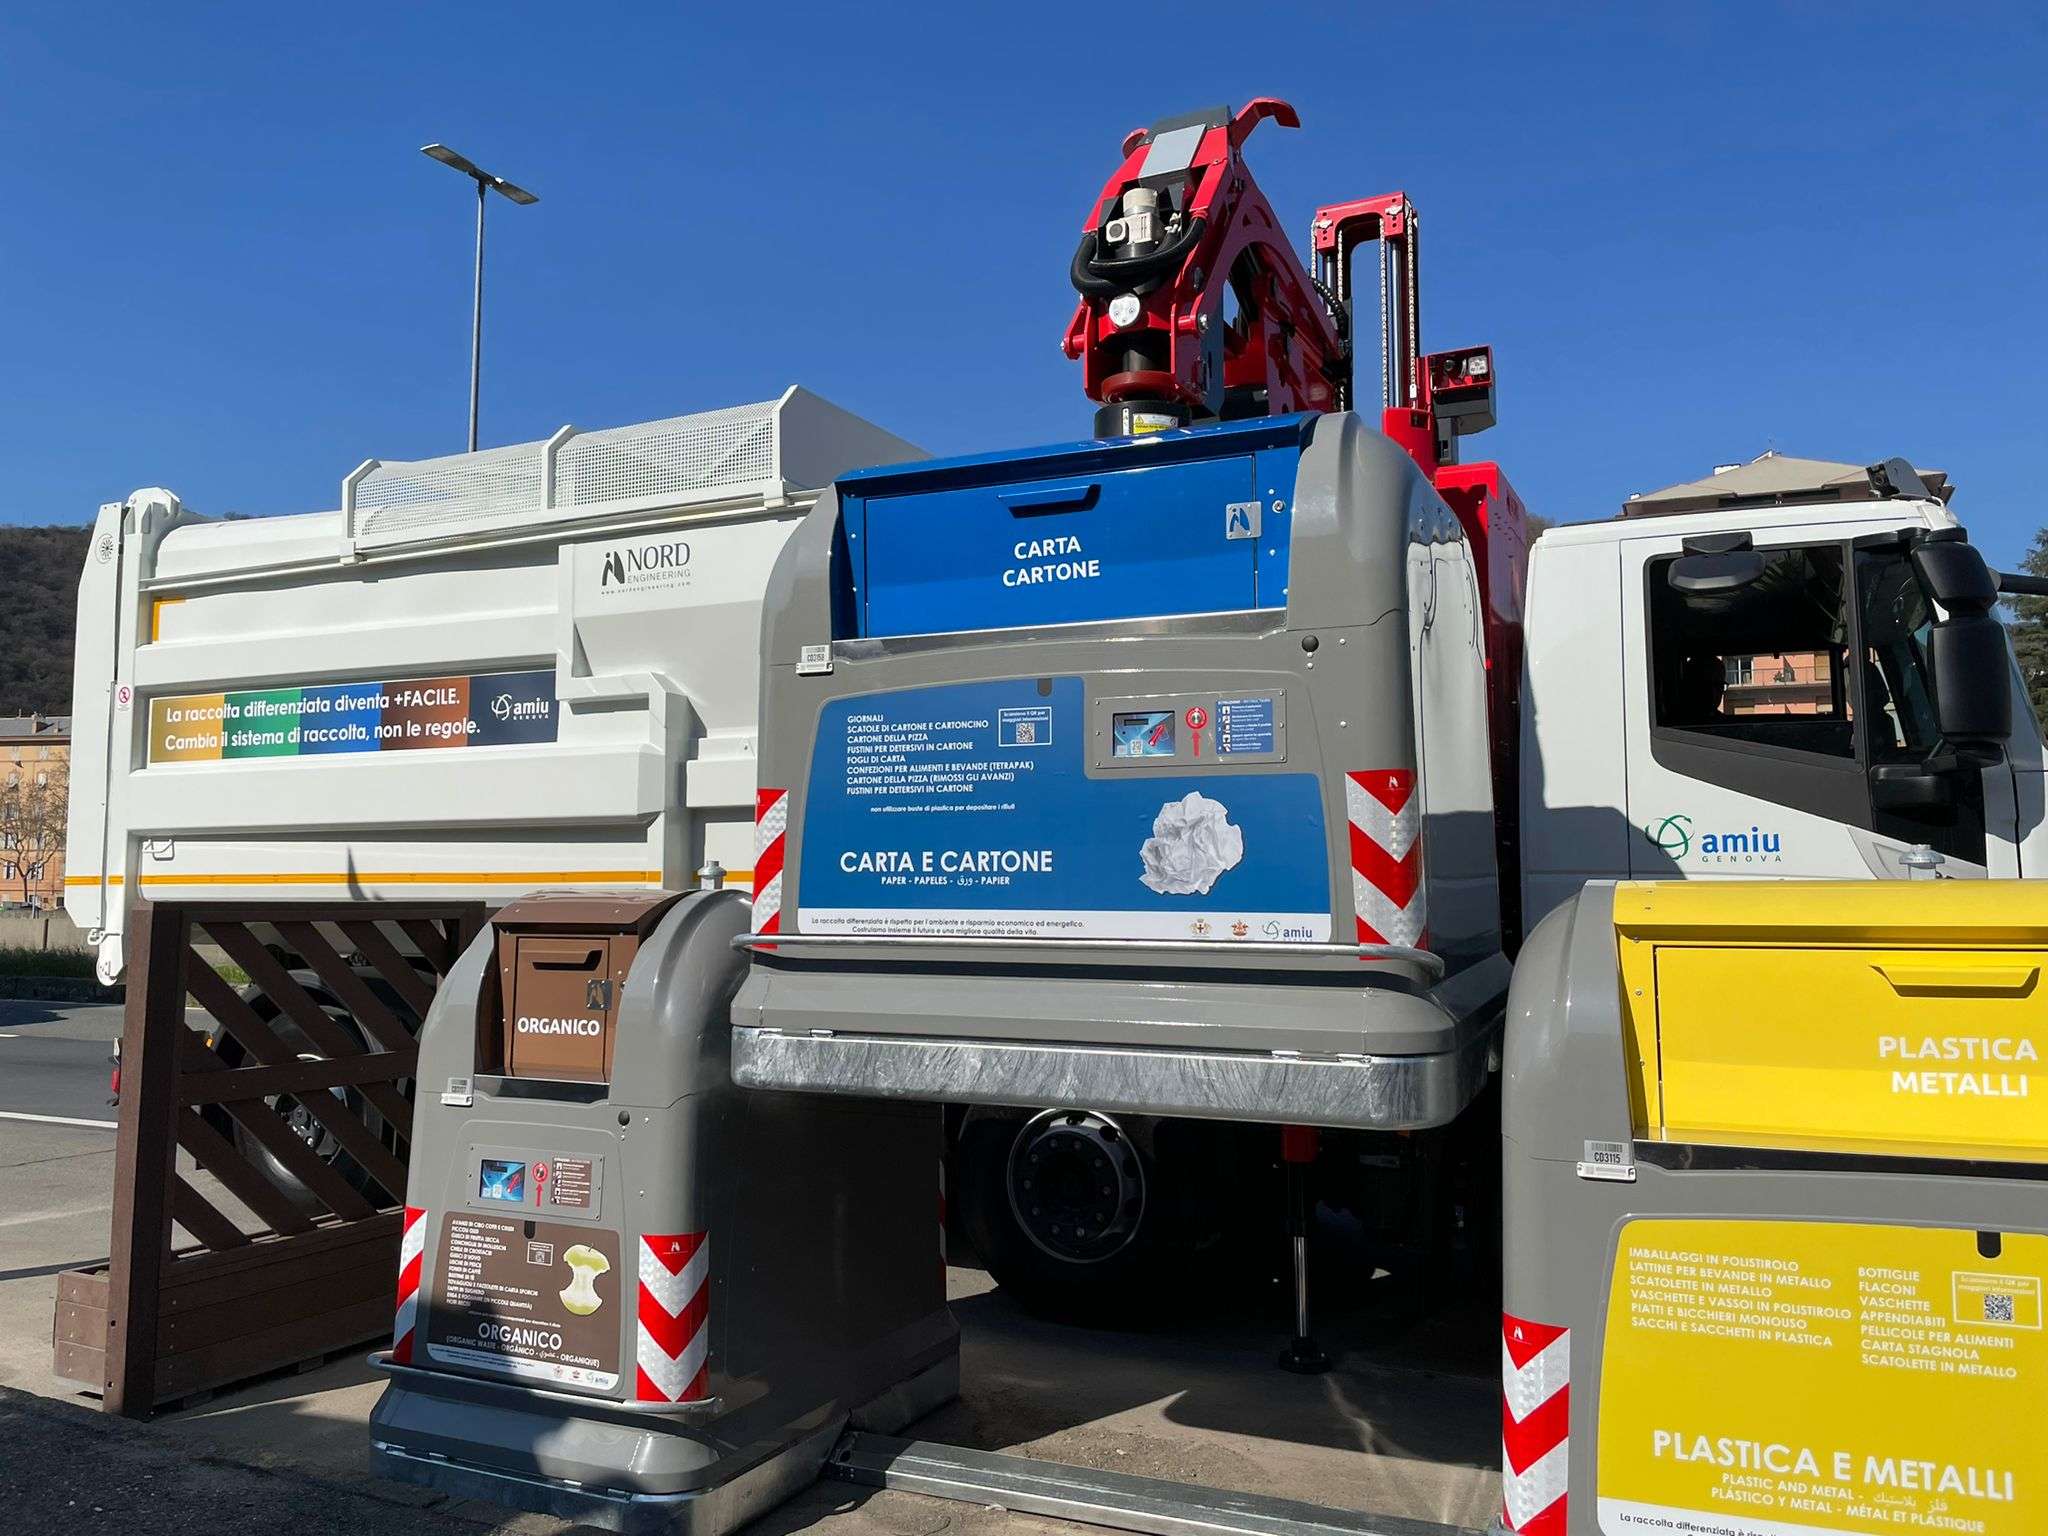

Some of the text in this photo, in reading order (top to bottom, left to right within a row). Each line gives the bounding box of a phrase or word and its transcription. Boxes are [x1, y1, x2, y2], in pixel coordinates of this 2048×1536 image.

[626, 542, 690, 572] NORD
[1014, 536, 1081, 560] CARTA
[628, 569, 691, 583] ENGINEERING
[1002, 560, 1100, 587] CARTONE
[167, 688, 460, 722] La raccolta differenziata diventa +FACILE.
[514, 699, 549, 717] amiu
[847, 715, 884, 724] GIORNALI
[847, 725, 880, 734] SCATOLE
[891, 723, 928, 732] CARTONE
[935, 720, 989, 730] CARTONCINO
[166, 717, 480, 751] Cambia il sistema di raccolta, non le regole.
[847, 733, 929, 744] CARTONE DELLA PIZZA
[847, 746, 874, 754] FUSTINI
[889, 743, 925, 752] DETERSIVI
[926, 743, 935, 751] IN
[936, 741, 973, 750] CARTONE
[847, 756, 870, 764] FOGLI
[880, 755, 906, 763] CARTA
[847, 766, 894, 775] CONFEZIONI
[909, 764, 944, 773] ALIMENTI
[951, 763, 988, 772] BEVANDE
[989, 761, 1034, 772] (TETRAPAK)
[846, 776, 883, 785] CARTONE
[884, 776, 907, 784] DELLA
[908, 775, 928, 783] PIZZA
[930, 773, 965, 783] (RIMOSSI
[980, 773, 1015, 782] AVANZI)
[889, 786, 925, 794] DETERSIVI
[936, 784, 974, 793] CARTONE
[1702, 826, 1780, 853] amiu
[840, 851, 1053, 873] CARTA E CARTONE
[881, 876, 907, 885] PAPER
[914, 876, 948, 885] PAPELES
[981, 876, 1010, 885] PAPIER
[1283, 926, 1312, 938] amiu
[518, 1017, 600, 1036] ORGANICO
[1878, 1036, 2038, 1061] PLASTICA
[1892, 1072, 2028, 1096] METALLI
[1629, 1248, 1800, 1272] IMBALLAGGI IN POLISTIROLO
[1630, 1262, 1832, 1289] LATTINE PER BEVANDE IN METALLO
[1630, 1275, 1772, 1298] SCATOLETTE IN METALLO
[1858, 1268, 1920, 1282] BOTTIGLIE
[1859, 1282, 1916, 1296] FLACONI
[1631, 1289, 1852, 1319] VASCHETTE E VASSOI IN POLISTIROLO
[1860, 1296, 1931, 1312] VASCHETTE
[1631, 1303, 1808, 1330] PIATTI E BICCHIERI MONOUSO
[1860, 1311, 1946, 1328] APPENDIABITI
[478, 1322, 562, 1350] ORGANICO
[1632, 1317, 1833, 1346] SACCHI E SACCHETTI IN PLASTICA
[1860, 1325, 2014, 1348] PELLICOLE PER ALIMENTI
[1861, 1339, 1980, 1360] CARTA STAGNOLA
[1862, 1354, 2017, 1378] SCATOLETTE IN METALLO
[1654, 1429, 2014, 1501] PLASTICA E METALLI
[1722, 1473, 1773, 1490] PLASTIC
[1778, 1480, 1807, 1494] AND
[1812, 1484, 1854, 1500] METAL
[1712, 1486, 1984, 1533] PLÁSTICO Y METAL MÉTAL ET PLASTIQUE
[1620, 1513, 1630, 1523] La
[1633, 1514, 1673, 1529] raccolta
[1676, 1520, 1735, 1536] differenziata
